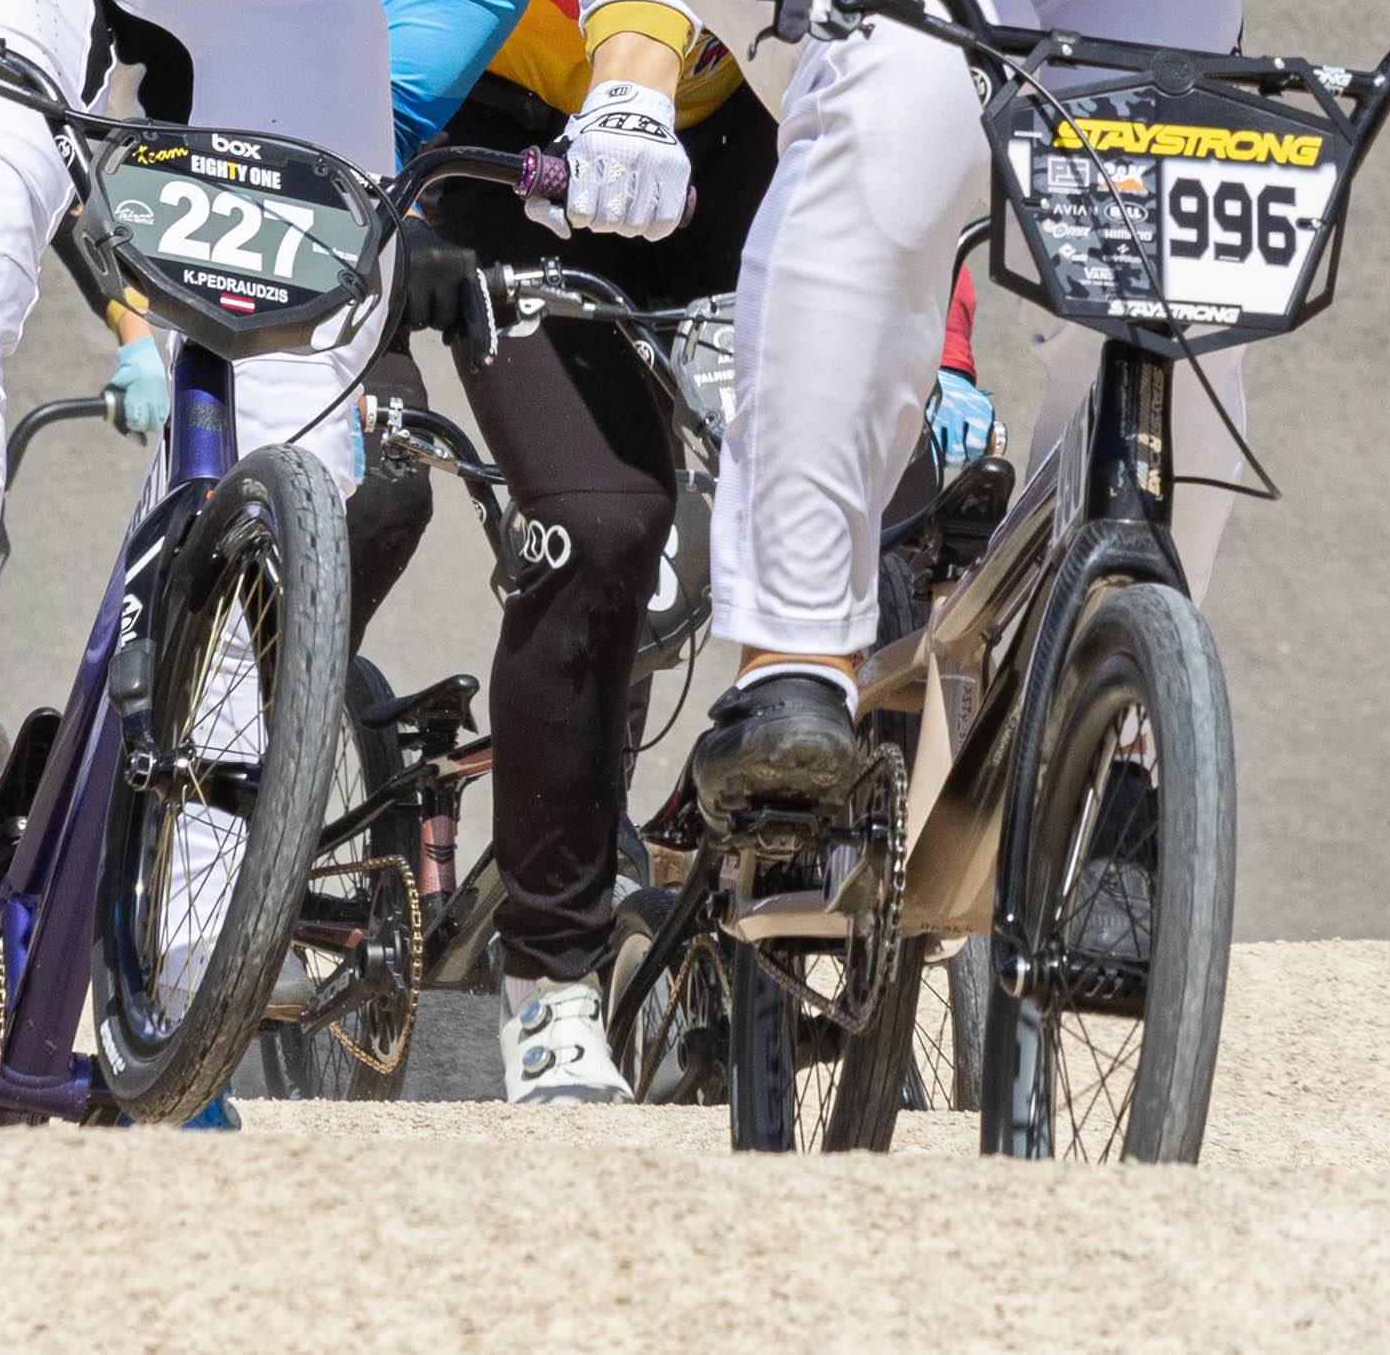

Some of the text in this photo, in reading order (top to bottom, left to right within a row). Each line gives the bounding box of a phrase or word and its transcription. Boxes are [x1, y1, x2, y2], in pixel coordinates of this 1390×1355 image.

[211, 133, 262, 160] box
[1054, 118, 1323, 167] STAYSTRONG
[190, 154, 282, 190] EIGHTY ONE
[157, 180, 315, 279] 227
[1168, 177, 1298, 268] 996
[183, 269, 289, 304] K.PEDRAUDZIS
